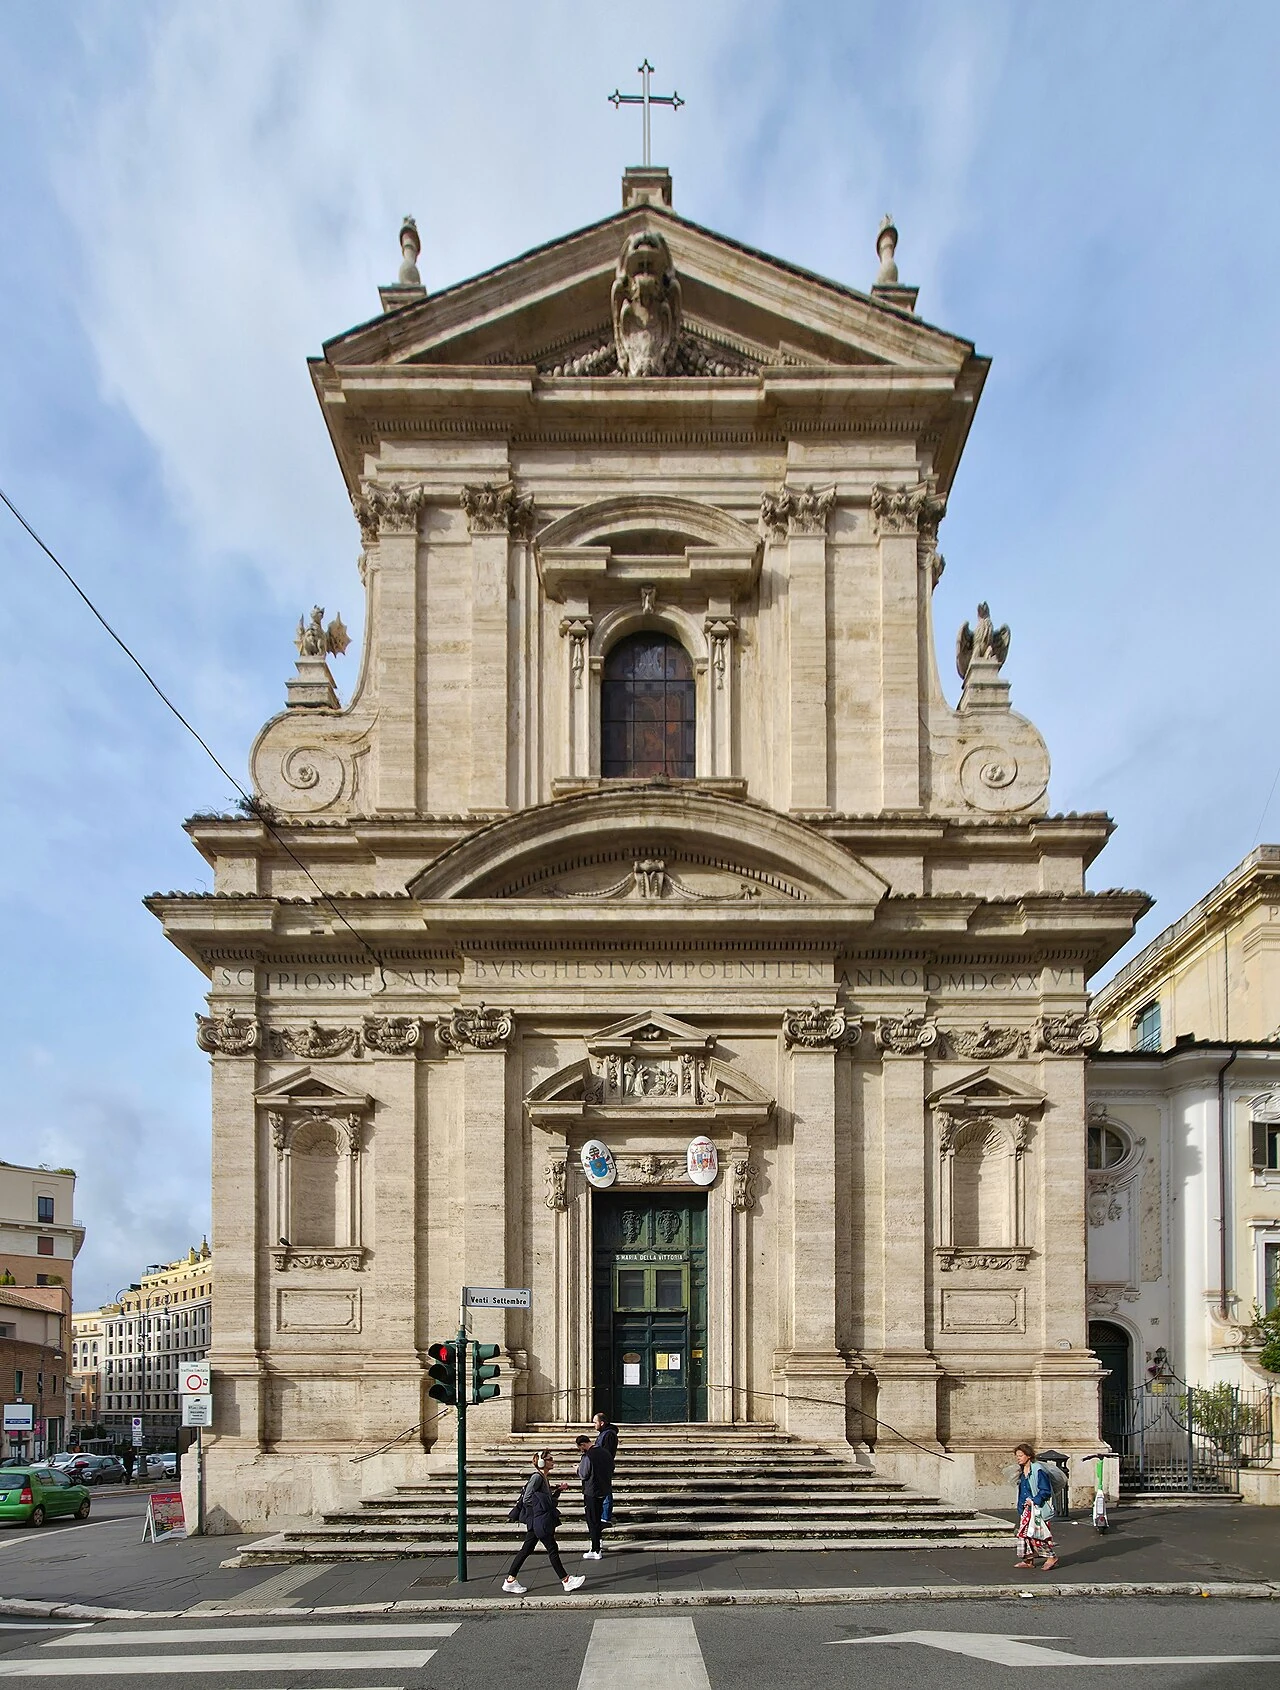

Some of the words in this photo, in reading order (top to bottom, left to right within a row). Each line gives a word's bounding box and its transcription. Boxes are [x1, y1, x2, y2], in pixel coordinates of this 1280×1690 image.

[474, 960, 647, 979] BVRGHESIVS
[684, 960, 824, 979] POENITEN
[839, 968, 918, 987] ANNO
[470, 1296, 489, 1304] Venti
[492, 1297, 527, 1305] Settembre
